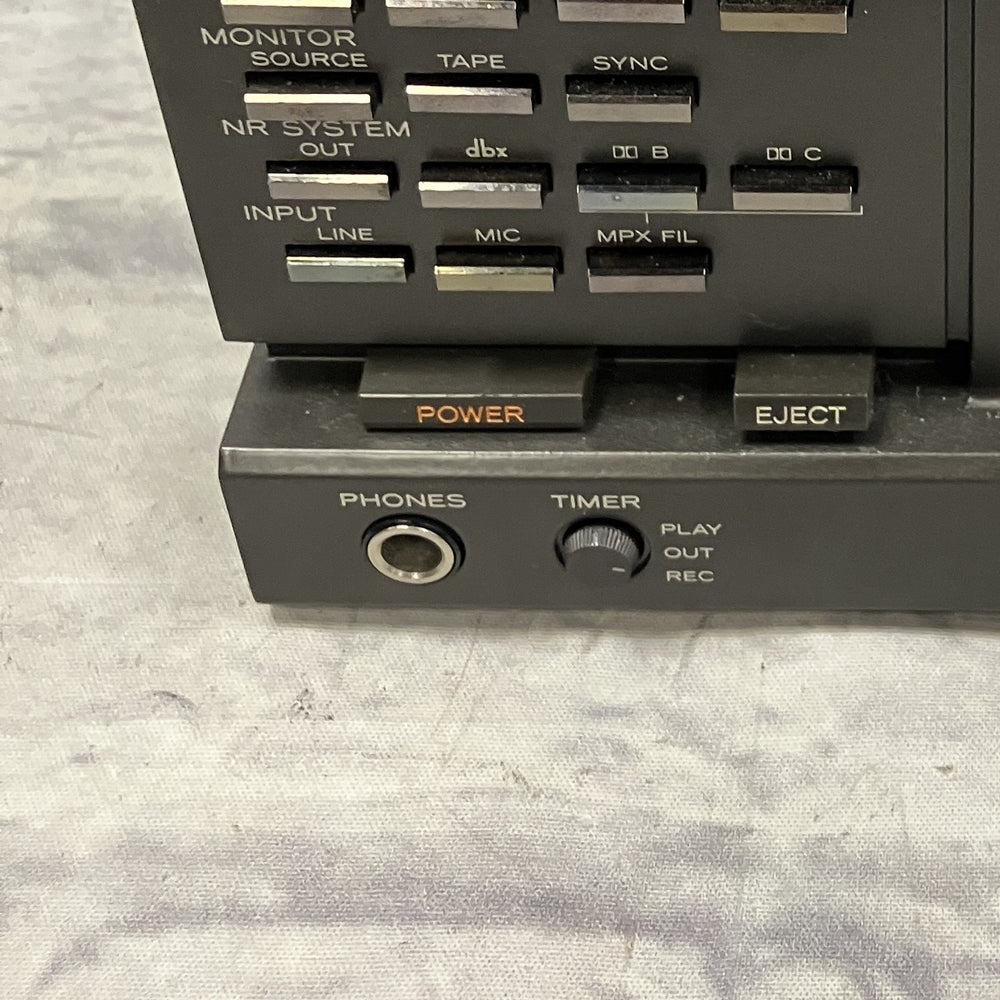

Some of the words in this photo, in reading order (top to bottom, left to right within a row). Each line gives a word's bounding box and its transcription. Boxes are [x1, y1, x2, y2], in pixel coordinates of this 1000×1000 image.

[201, 27, 357, 47] MONITOR
[251, 51, 369, 68] SOURCE
[437, 54, 507, 70] TAPE
[592, 56, 669, 72] SYNC
[221, 118, 269, 137] NR
[283, 120, 411, 138] SYSTEM
[300, 142, 355, 158] OUT
[465, 138, 509, 159] dbx
[651, 146, 669, 160] B
[803, 147, 823, 162] C
[243, 205, 337, 222] INPUT
[317, 227, 375, 242] LINE
[475, 228, 522, 243] MIC
[597, 229, 653, 244] MPX
[661, 229, 699, 244] FIL
[416, 405, 526, 424] POWER
[755, 406, 847, 425] EJECT
[339, 492, 468, 509] PHONES
[550, 494, 641, 510] TIMER
[660, 523, 723, 537] PLAY
[663, 546, 715, 560] OUT
[666, 570, 715, 583] REC
